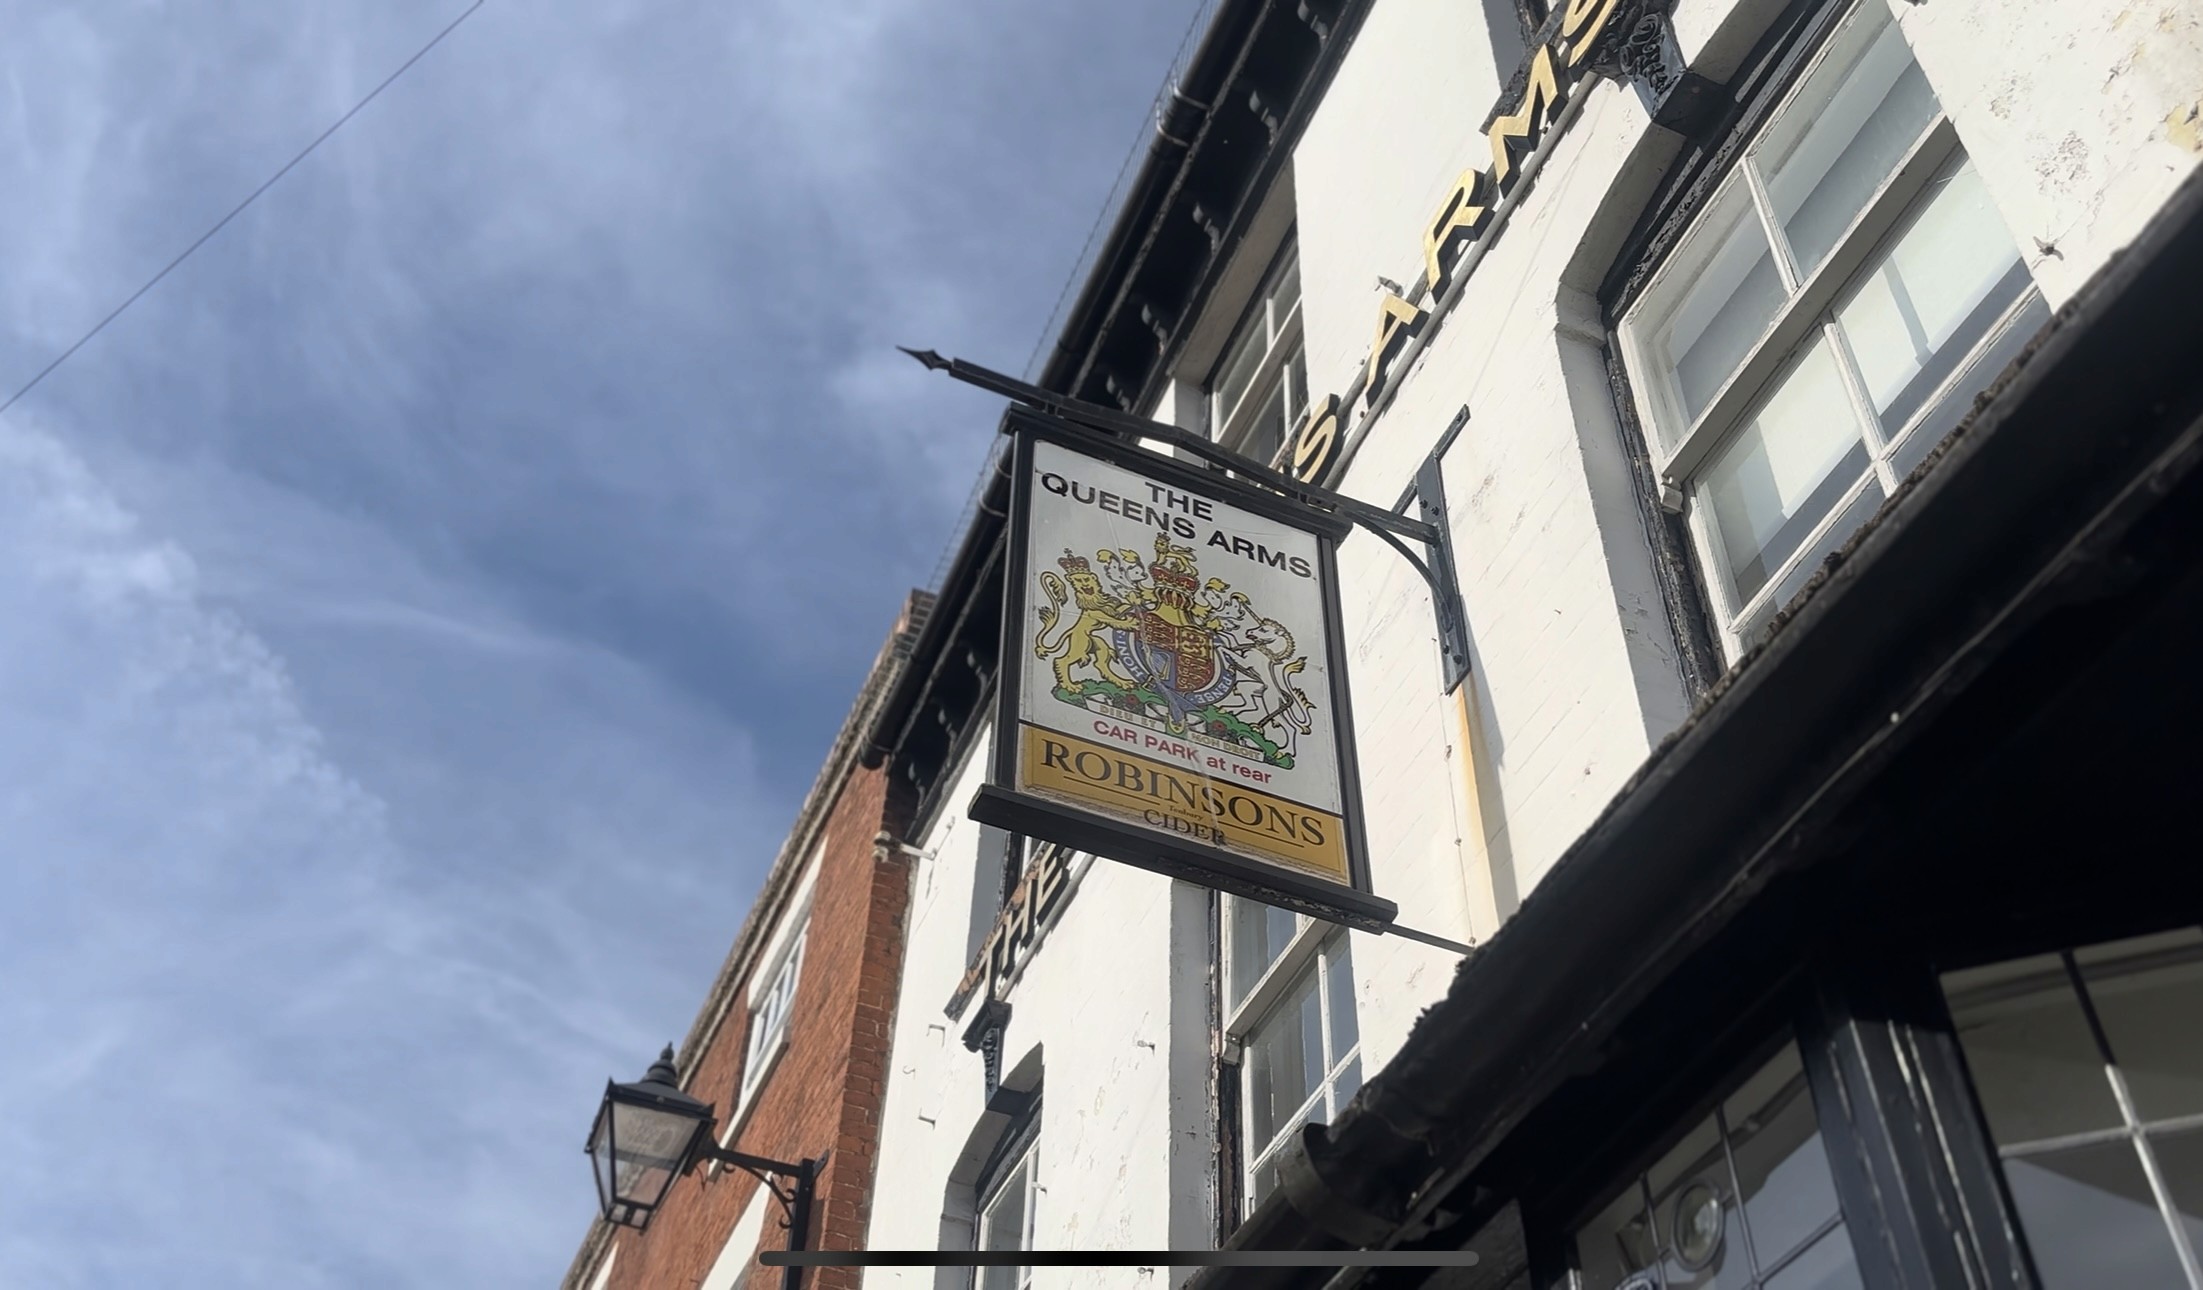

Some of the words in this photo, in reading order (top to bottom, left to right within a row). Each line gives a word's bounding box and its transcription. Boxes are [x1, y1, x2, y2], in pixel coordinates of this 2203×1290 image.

[1041, 472, 1196, 540] QUEENS
[1207, 530, 1312, 578] ARMS
[1145, 481, 1213, 522] THE
[1099, 704, 1134, 721] DIEU
[1141, 717, 1157, 728] ET
[1093, 720, 1138, 745] CAR
[1144, 734, 1200, 764] PARK
[1206, 754, 1227, 772] at
[1232, 763, 1272, 785] rear
[1041, 738, 1325, 847] ROBINSONS
[1143, 809, 1228, 846] CIDER
[977, 842, 1063, 1001] THE
